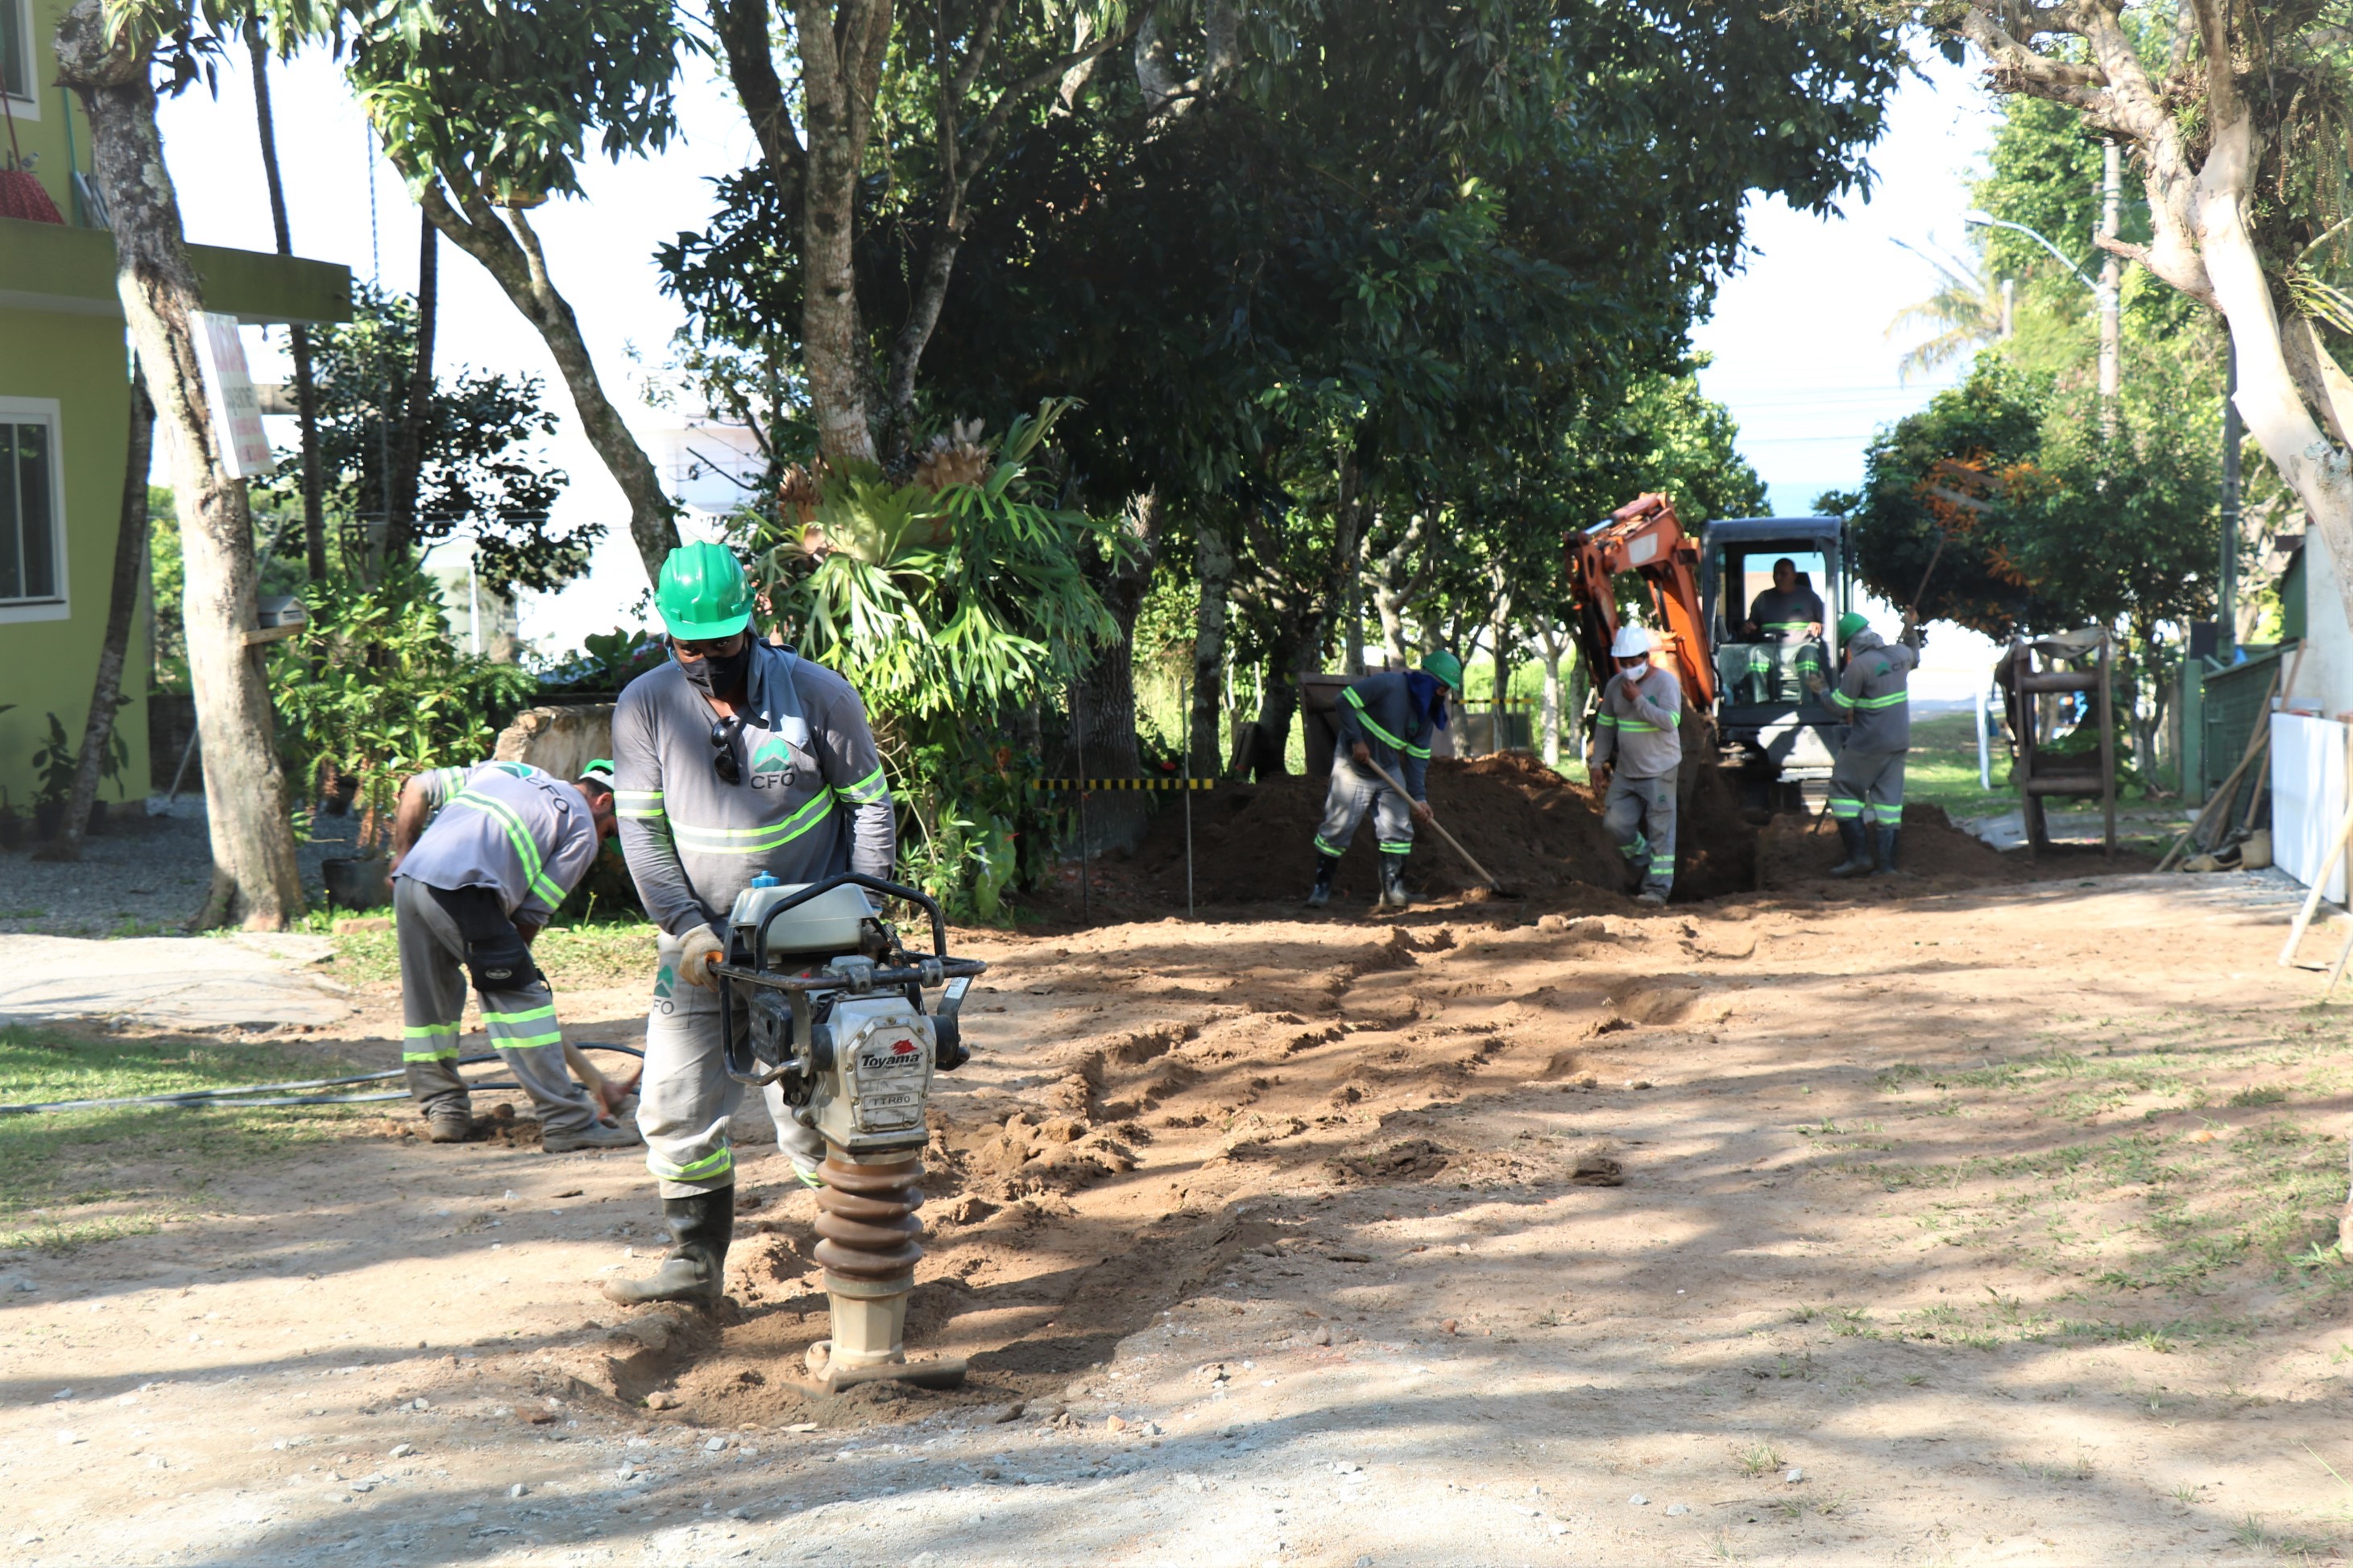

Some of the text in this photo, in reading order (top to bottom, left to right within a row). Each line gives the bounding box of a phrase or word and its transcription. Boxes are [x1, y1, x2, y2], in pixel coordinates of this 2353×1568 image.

[751, 773, 795, 789] CFO
[526, 777, 570, 814] CFO
[653, 999, 674, 1015] FO
[862, 1054, 920, 1069] Toyama
